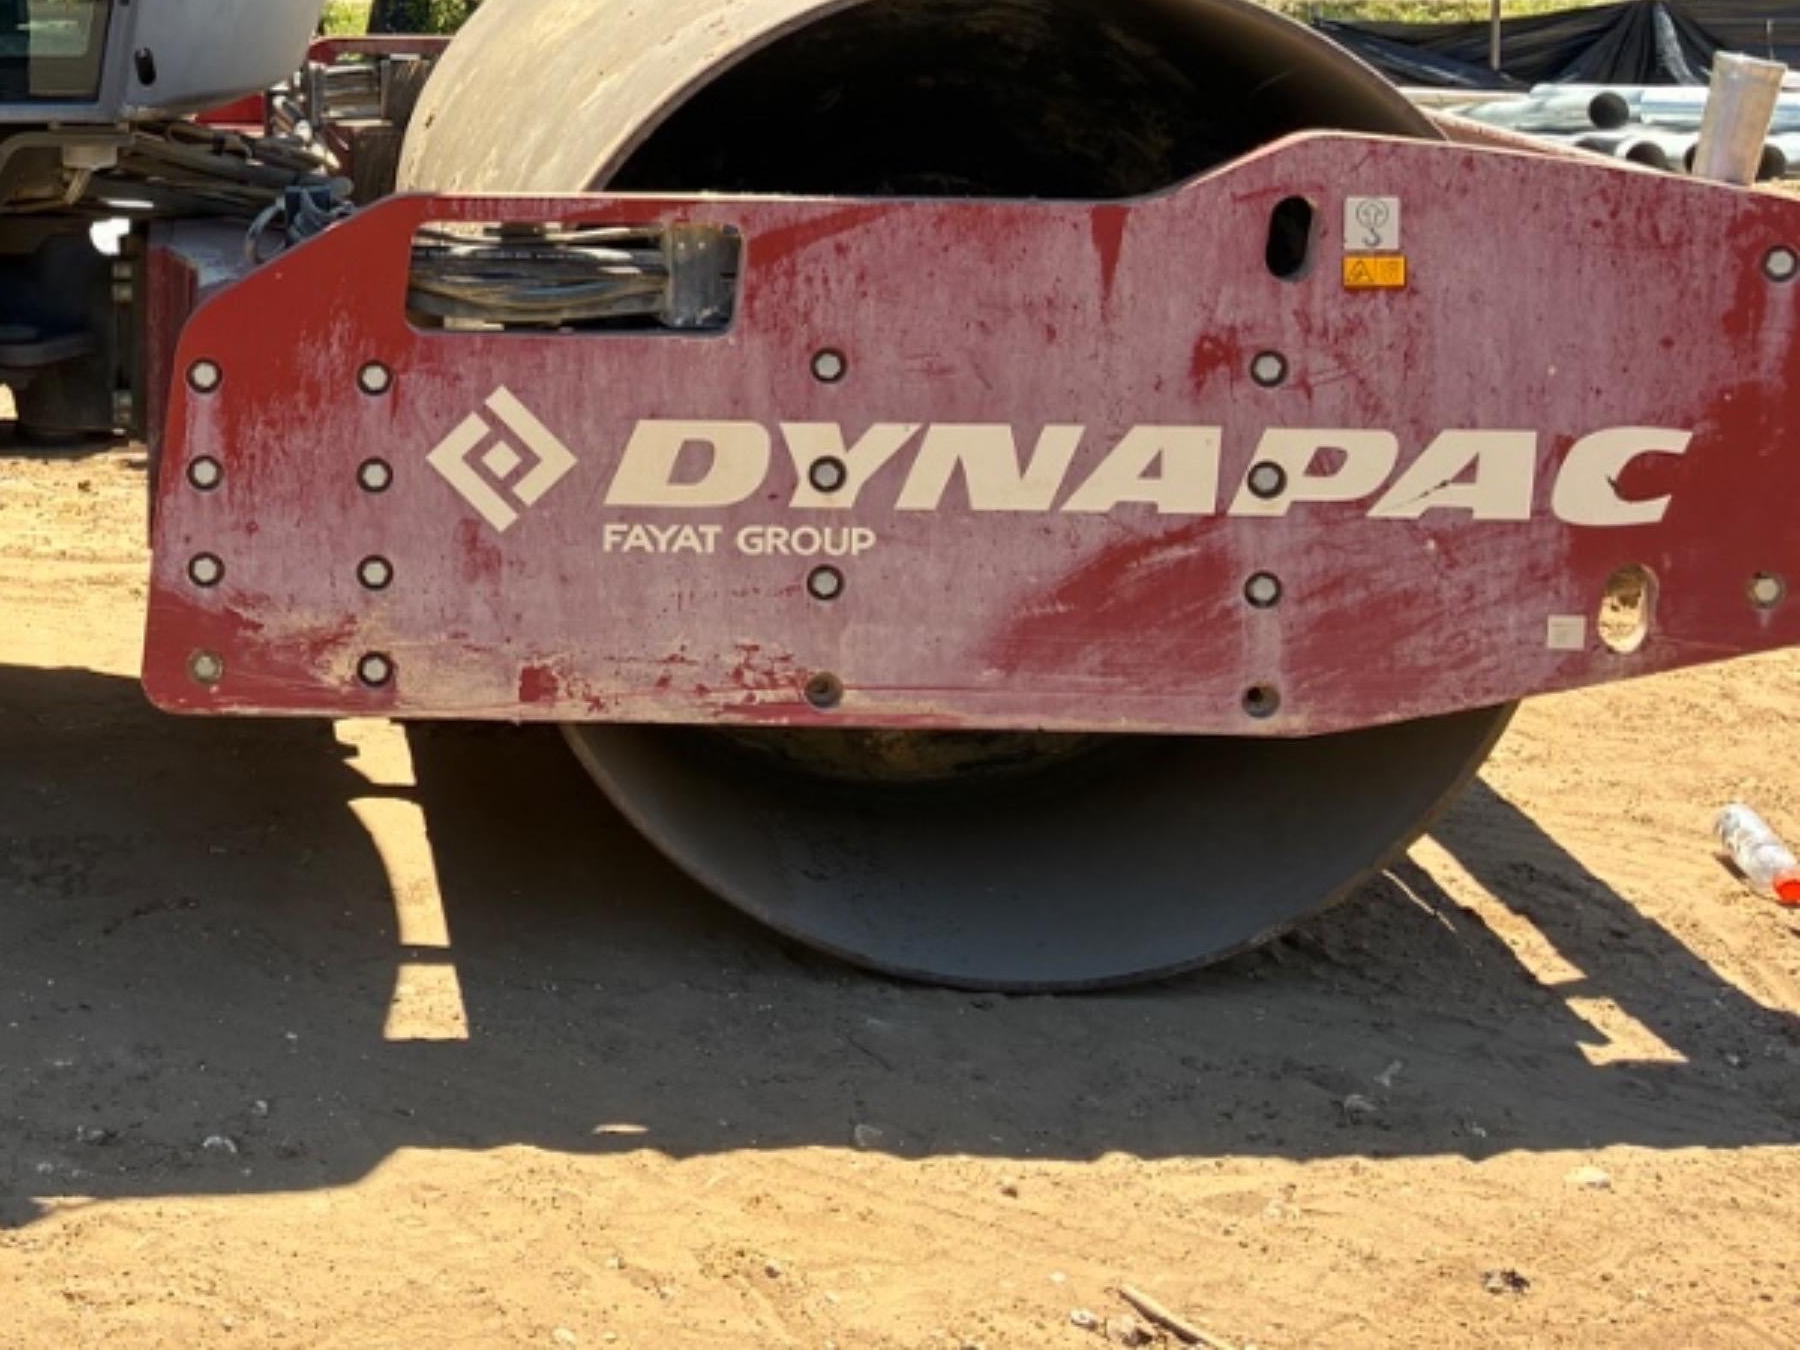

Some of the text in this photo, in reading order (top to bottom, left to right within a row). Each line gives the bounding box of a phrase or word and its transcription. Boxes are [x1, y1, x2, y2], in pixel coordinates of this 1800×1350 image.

[603, 418, 1693, 527] DYNAPAC
[602, 522, 877, 557] FAYAT GROUP
